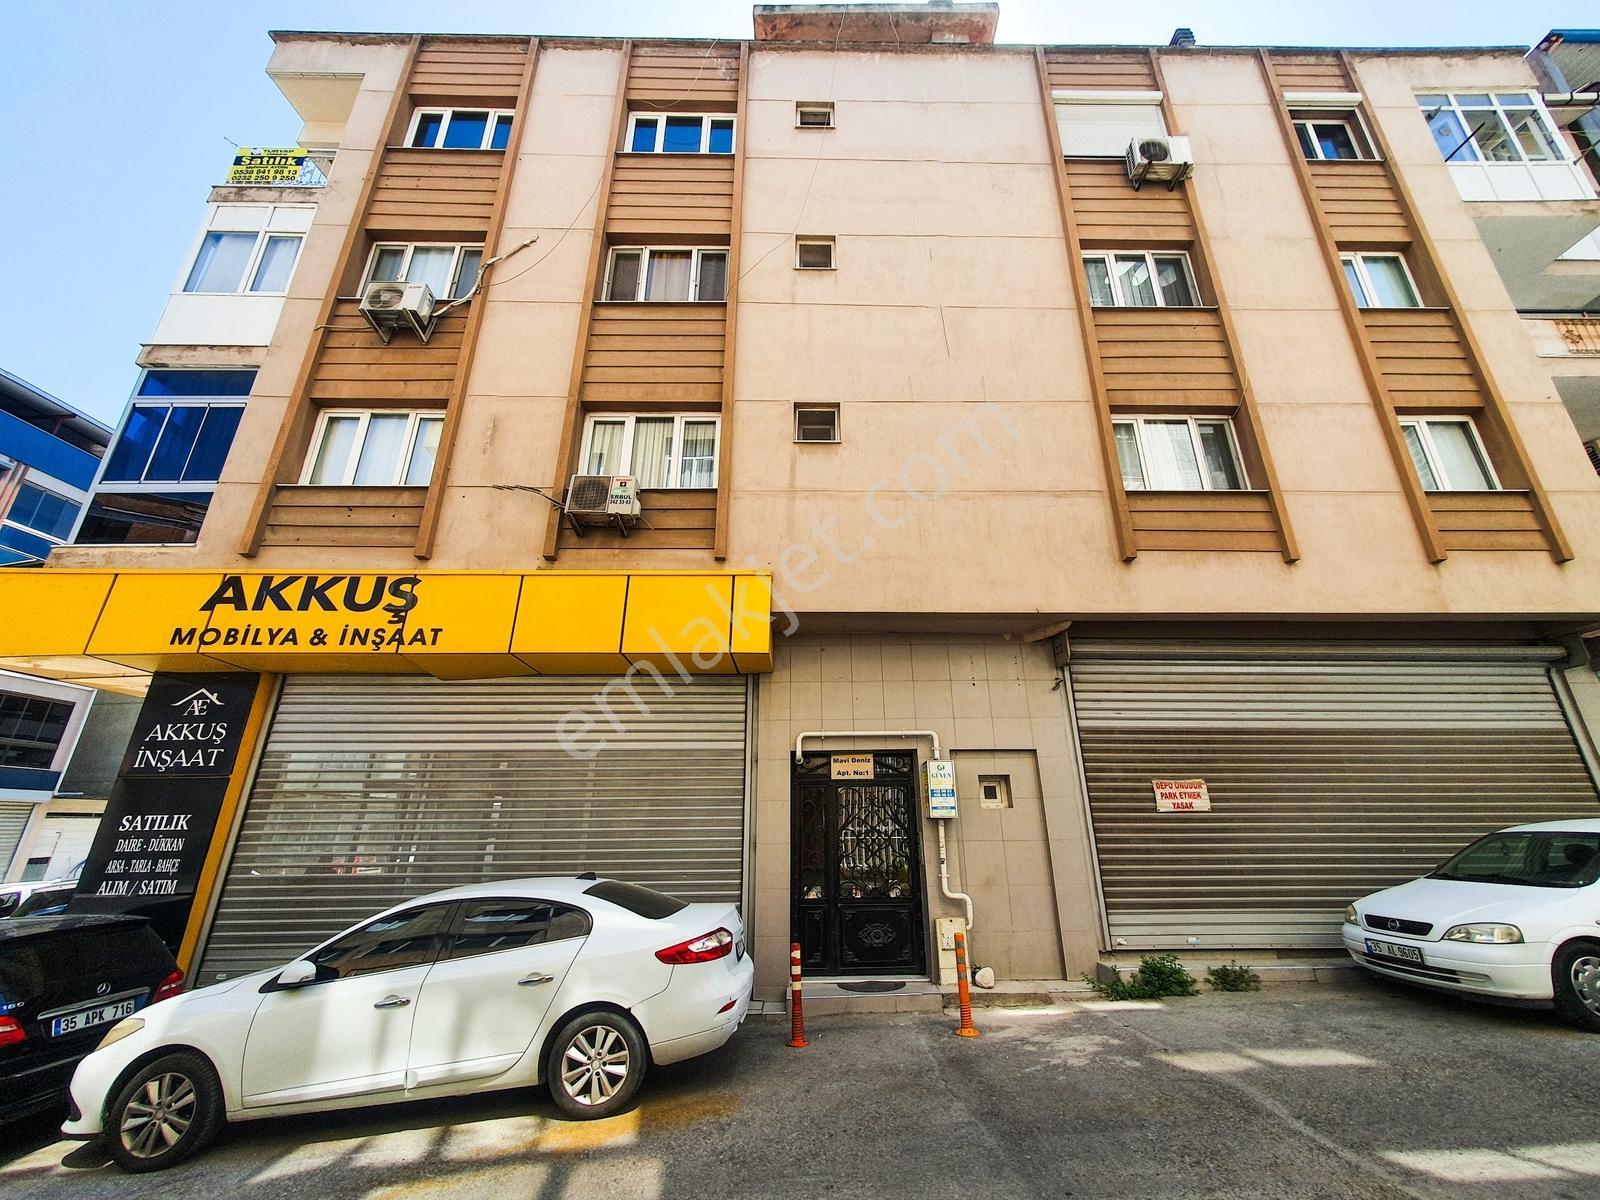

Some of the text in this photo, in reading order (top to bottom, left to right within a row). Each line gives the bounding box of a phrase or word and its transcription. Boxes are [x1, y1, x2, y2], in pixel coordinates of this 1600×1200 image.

[199, 575, 422, 625] AKKUŞ
[169, 624, 443, 651] MOBİLYA & İNŞAAT
[145, 722, 228, 744] AKKUŞ
[133, 746, 224, 772] İNŞAAT
[1155, 782, 1173, 790] DEPO
[1160, 791, 1202, 800] PARK ETMEK
[1171, 802, 1194, 810] YASAK
[118, 814, 192, 832] SATILIK
[115, 835, 143, 853] DAİRE
[147, 834, 185, 852] DÜKKAN
[105, 859, 125, 874] ARSA
[129, 859, 152, 873] TARLA
[155, 859, 180, 876] BAHÇE
[96, 880, 129, 896] ALIM
[138, 880, 178, 895] SATIM
[1372, 941, 1418, 960] 35 AL 9605
[62, 1003, 133, 1032] 35 APK 716
